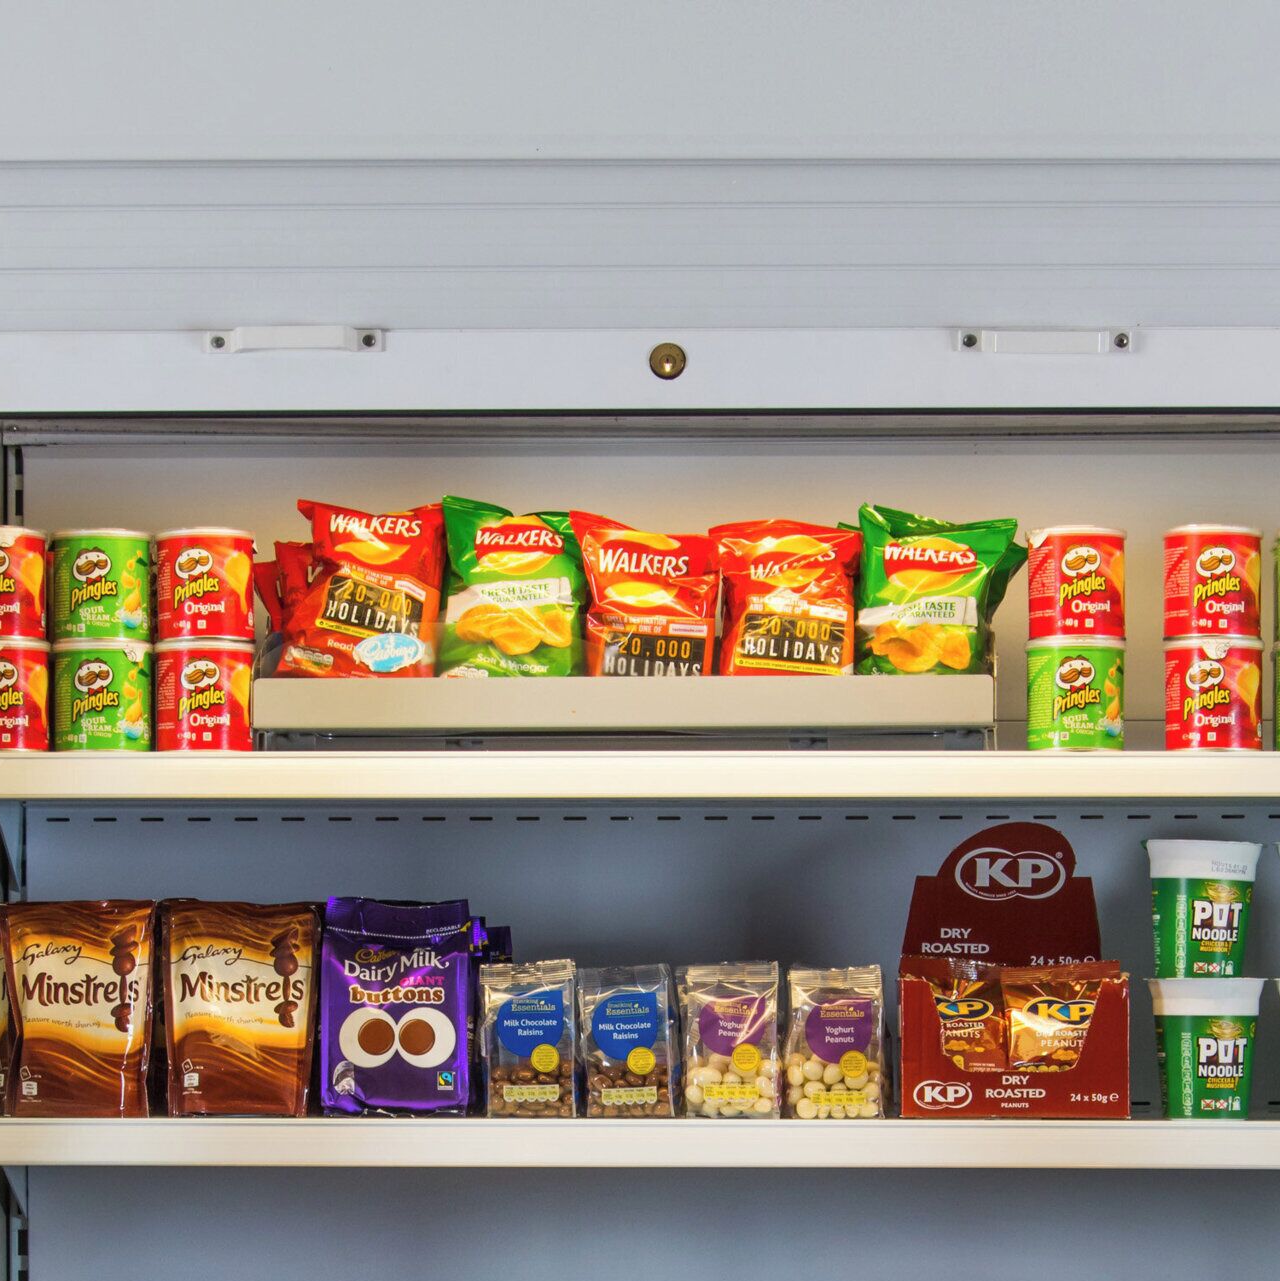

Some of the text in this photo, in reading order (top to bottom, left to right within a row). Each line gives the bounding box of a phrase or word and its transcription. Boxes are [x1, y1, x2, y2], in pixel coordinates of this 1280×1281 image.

[329, 513, 423, 538] WALKERS
[475, 528, 565, 549] WALKERS
[598, 547, 690, 578] WALKERS
[884, 545, 976, 565] WALKERS
[70, 577, 118, 611] Pringles
[173, 576, 220, 609] Pringles
[1059, 573, 1107, 606] Pringles
[1192, 573, 1241, 608] Pringles
[184, 601, 226, 616] Original
[925, 601, 957, 611] TASTE
[1071, 599, 1111, 615] Original
[1205, 599, 1245, 616] Original
[326, 599, 419, 638] HOLIDAYS
[619, 635, 691, 659] 20,000
[744, 636, 840, 665] HOLIDAYS
[604, 655, 701, 677] HOLIDAYS
[72, 690, 119, 723] Pringles
[177, 689, 226, 722] Pringles
[1052, 688, 1101, 722] Pringles
[1182, 687, 1231, 722] Pringles
[189, 713, 231, 728] Original
[1194, 712, 1236, 728] Original
[974, 857, 1055, 889] KP
[1193, 901, 1243, 927] POT
[939, 927, 972, 940] DRY
[1192, 927, 1238, 942] NOODLE
[21, 943, 84, 967] Galaxy
[180, 944, 244, 967] Galaxy
[921, 942, 990, 955] ROASTED
[343, 949, 450, 984] Dairy Milk
[1030, 955, 1045, 966] 24
[179, 971, 305, 1006] Minstrels
[399, 975, 446, 988] GIANT
[348, 984, 446, 1005] buttons
[511, 1002, 556, 1012] Essentials
[605, 1006, 650, 1016] Essentials
[819, 1009, 865, 1018] Essentials
[936, 1000, 984, 1016] KP
[1036, 1002, 1095, 1022] KP
[503, 1018, 558, 1027] Milk Chocolate
[598, 1022, 652, 1031] Milk Chocolate
[824, 1025, 855, 1036] Yoghurt
[517, 1028, 544, 1036] Raisins
[612, 1032, 639, 1040] Raisins
[717, 1028, 746, 1037] Peanu
[824, 1035, 855, 1044] Peanuts
[943, 1029, 981, 1039] ANUTS
[1054, 1029, 1088, 1037] ROASTE
[1040, 1039, 1085, 1048] PEANUT
[1198, 1037, 1248, 1064] POT
[1198, 1064, 1244, 1079] NOODLE
[1001, 1074, 1030, 1086] DRY
[923, 1085, 967, 1104] KP
[985, 1088, 1046, 1099] ROASTED
[1070, 1092, 1082, 1102] 24
[1091, 1092, 1109, 1104] 50g
[1000, 1101, 1030, 1109] PEANUTS
